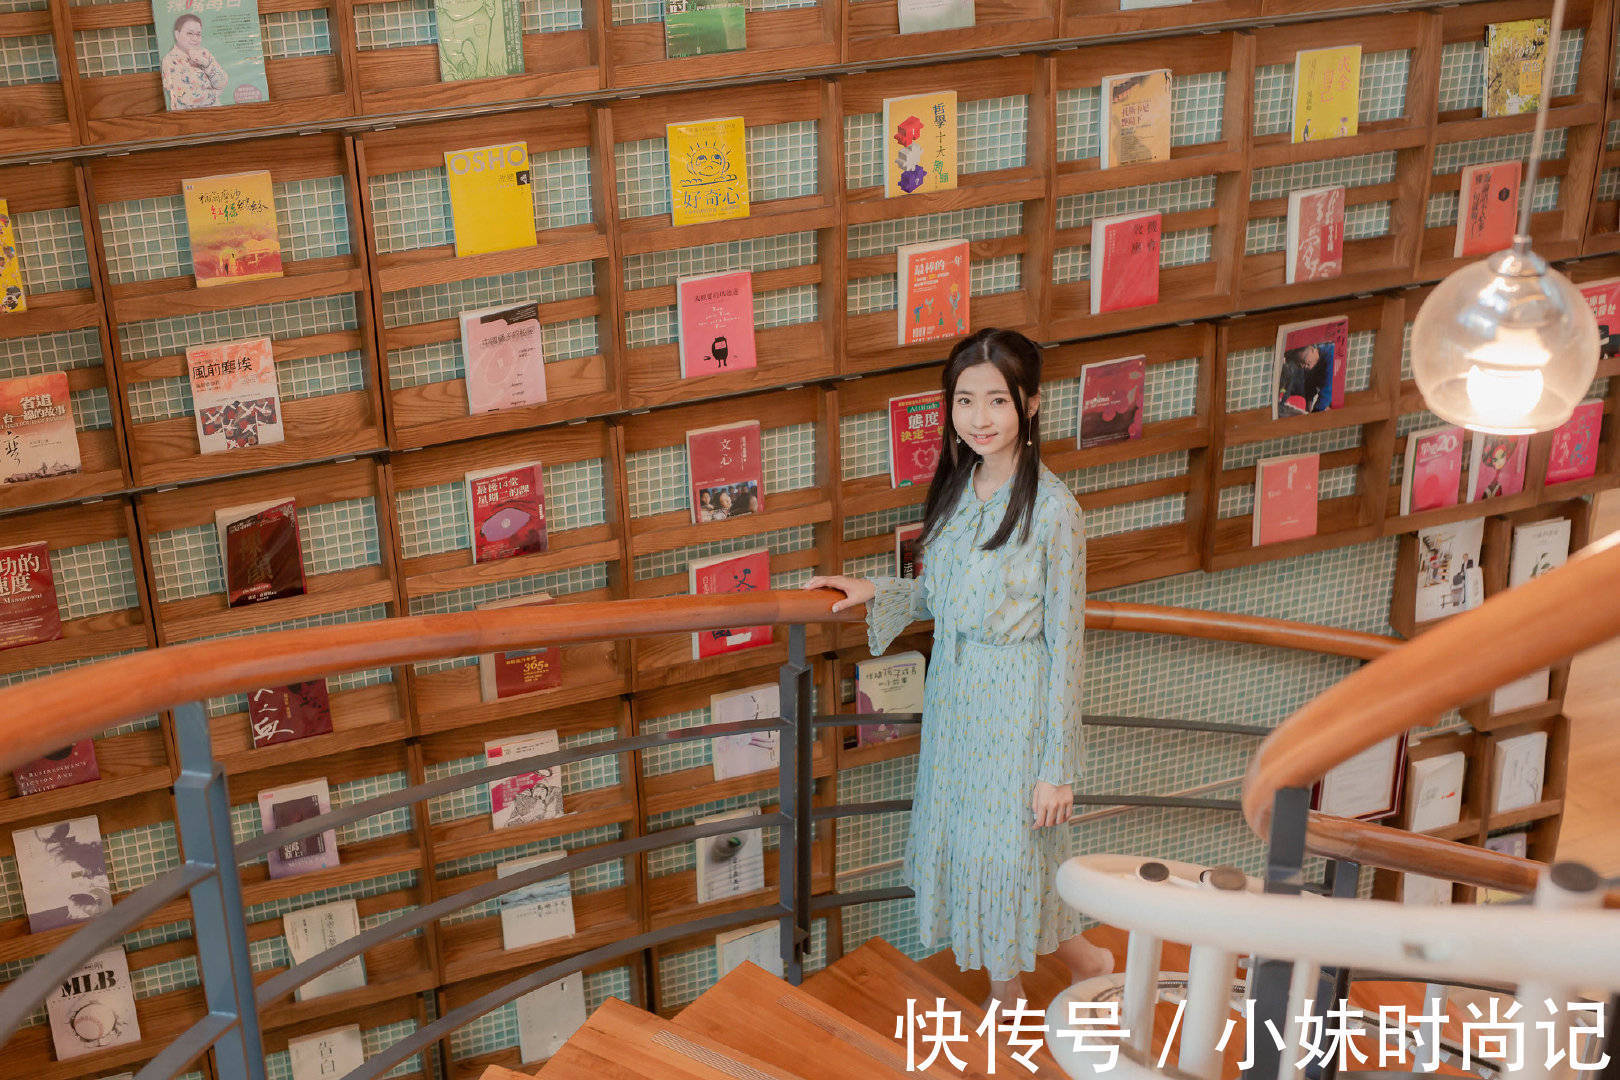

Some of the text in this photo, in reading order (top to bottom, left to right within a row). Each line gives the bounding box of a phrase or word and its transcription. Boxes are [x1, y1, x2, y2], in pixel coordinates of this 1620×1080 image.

[450, 145, 527, 175] OSHO
[683, 187, 740, 209] 好奇心
[192, 356, 253, 379] 風前塵埃
[908, 411, 940, 430] 態度
[720, 438, 732, 466] 文心
[523, 660, 545, 672] 365
[60, 970, 117, 998] MLB
